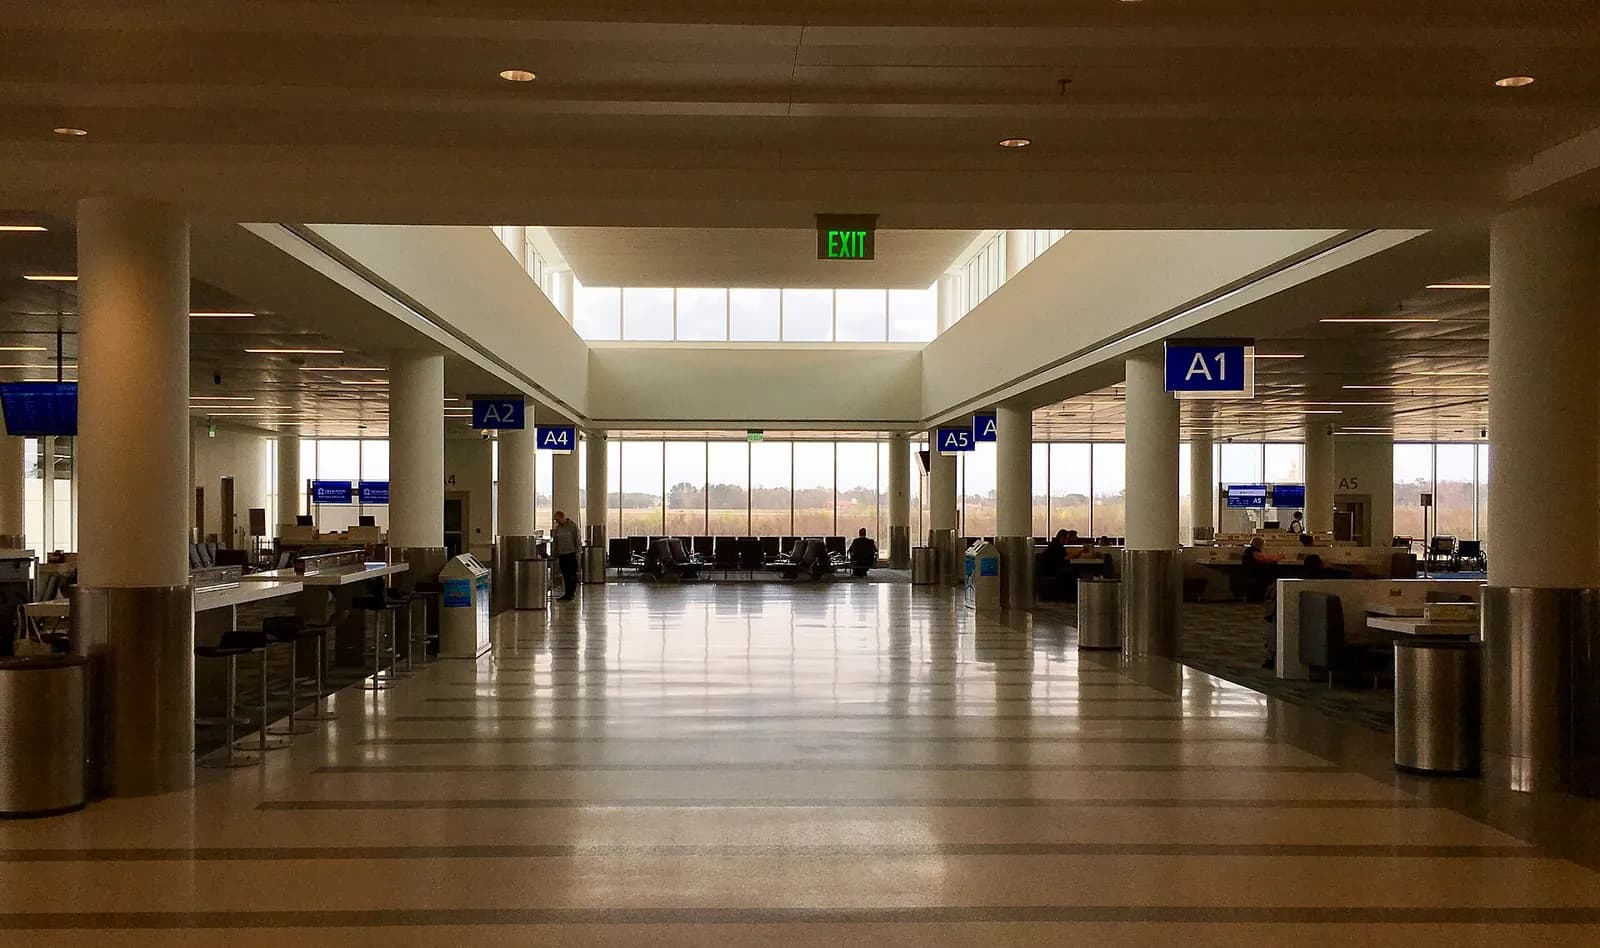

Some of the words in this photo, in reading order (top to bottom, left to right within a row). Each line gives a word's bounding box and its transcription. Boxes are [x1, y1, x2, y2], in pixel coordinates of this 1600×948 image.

[828, 229, 867, 258] EXIT
[1185, 352, 1226, 381] A1
[483, 402, 515, 424] A2
[544, 430, 568, 446] A4
[944, 431, 968, 448] A5
[1339, 477, 1358, 489] A5
